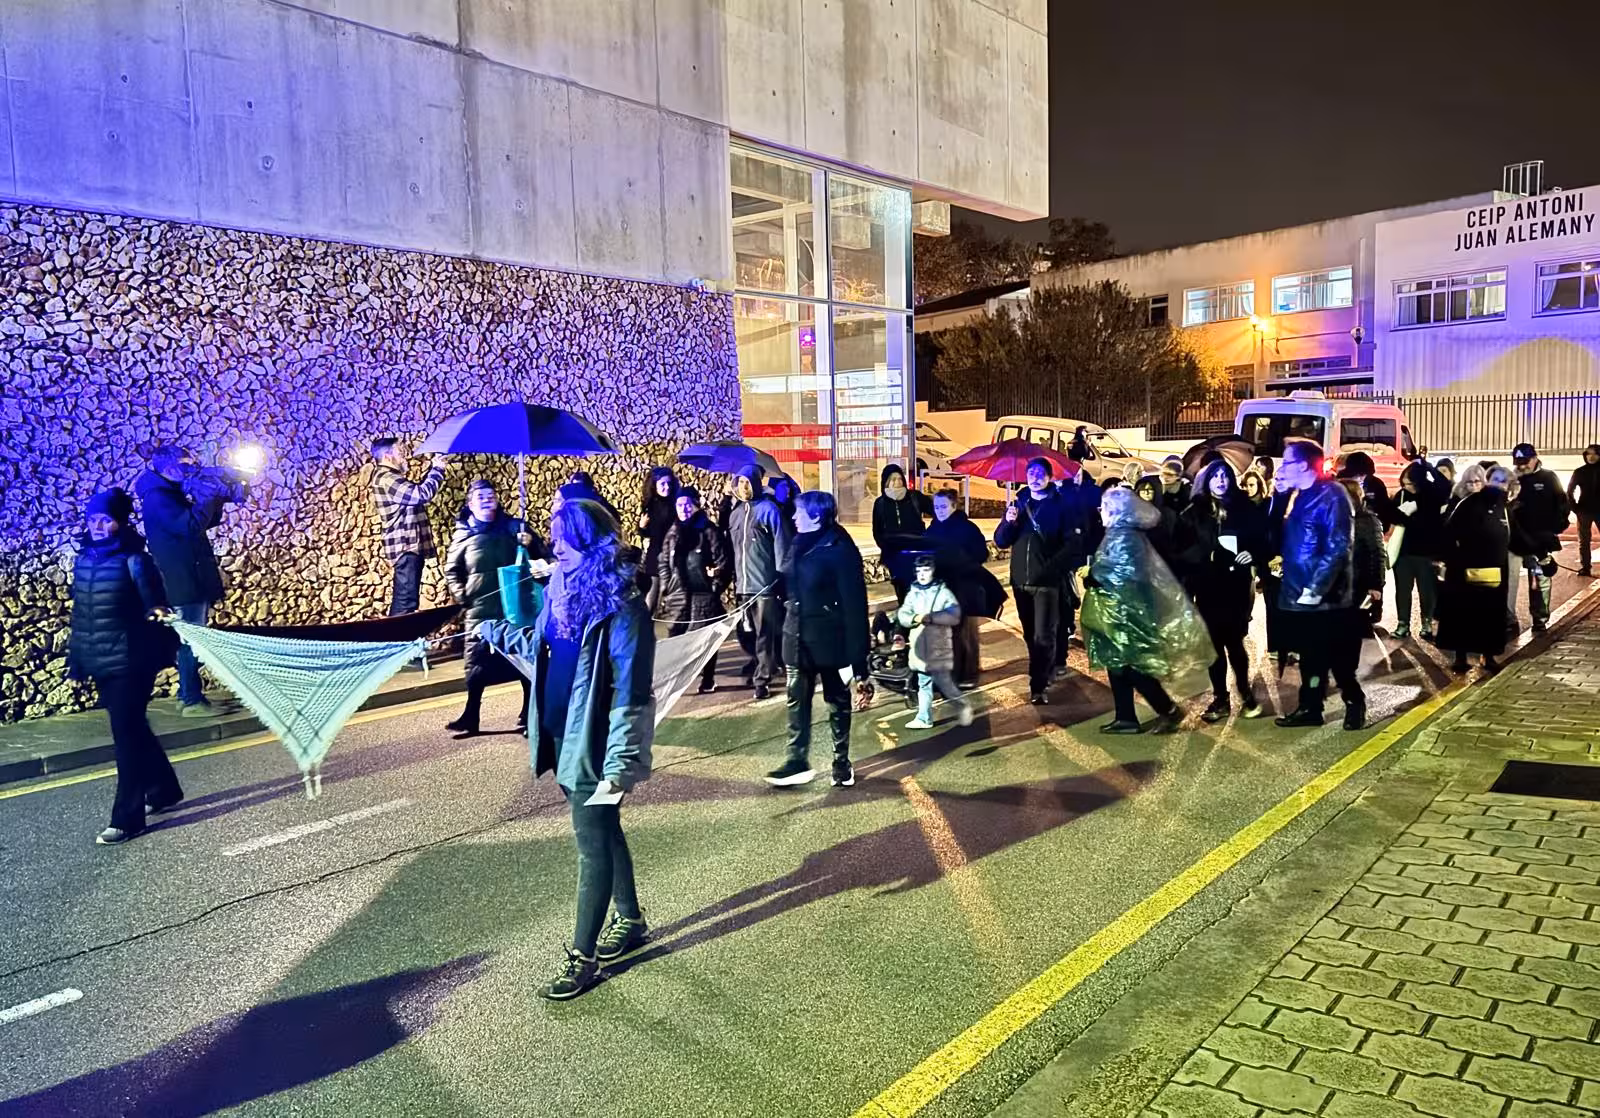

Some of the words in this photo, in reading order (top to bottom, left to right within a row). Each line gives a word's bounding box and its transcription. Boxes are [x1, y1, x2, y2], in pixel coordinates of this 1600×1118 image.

[1467, 206, 1506, 228] CEIP
[1514, 193, 1583, 221] ANTONI
[1454, 228, 1497, 251] JUAN
[1505, 214, 1595, 244] ALEMANY
